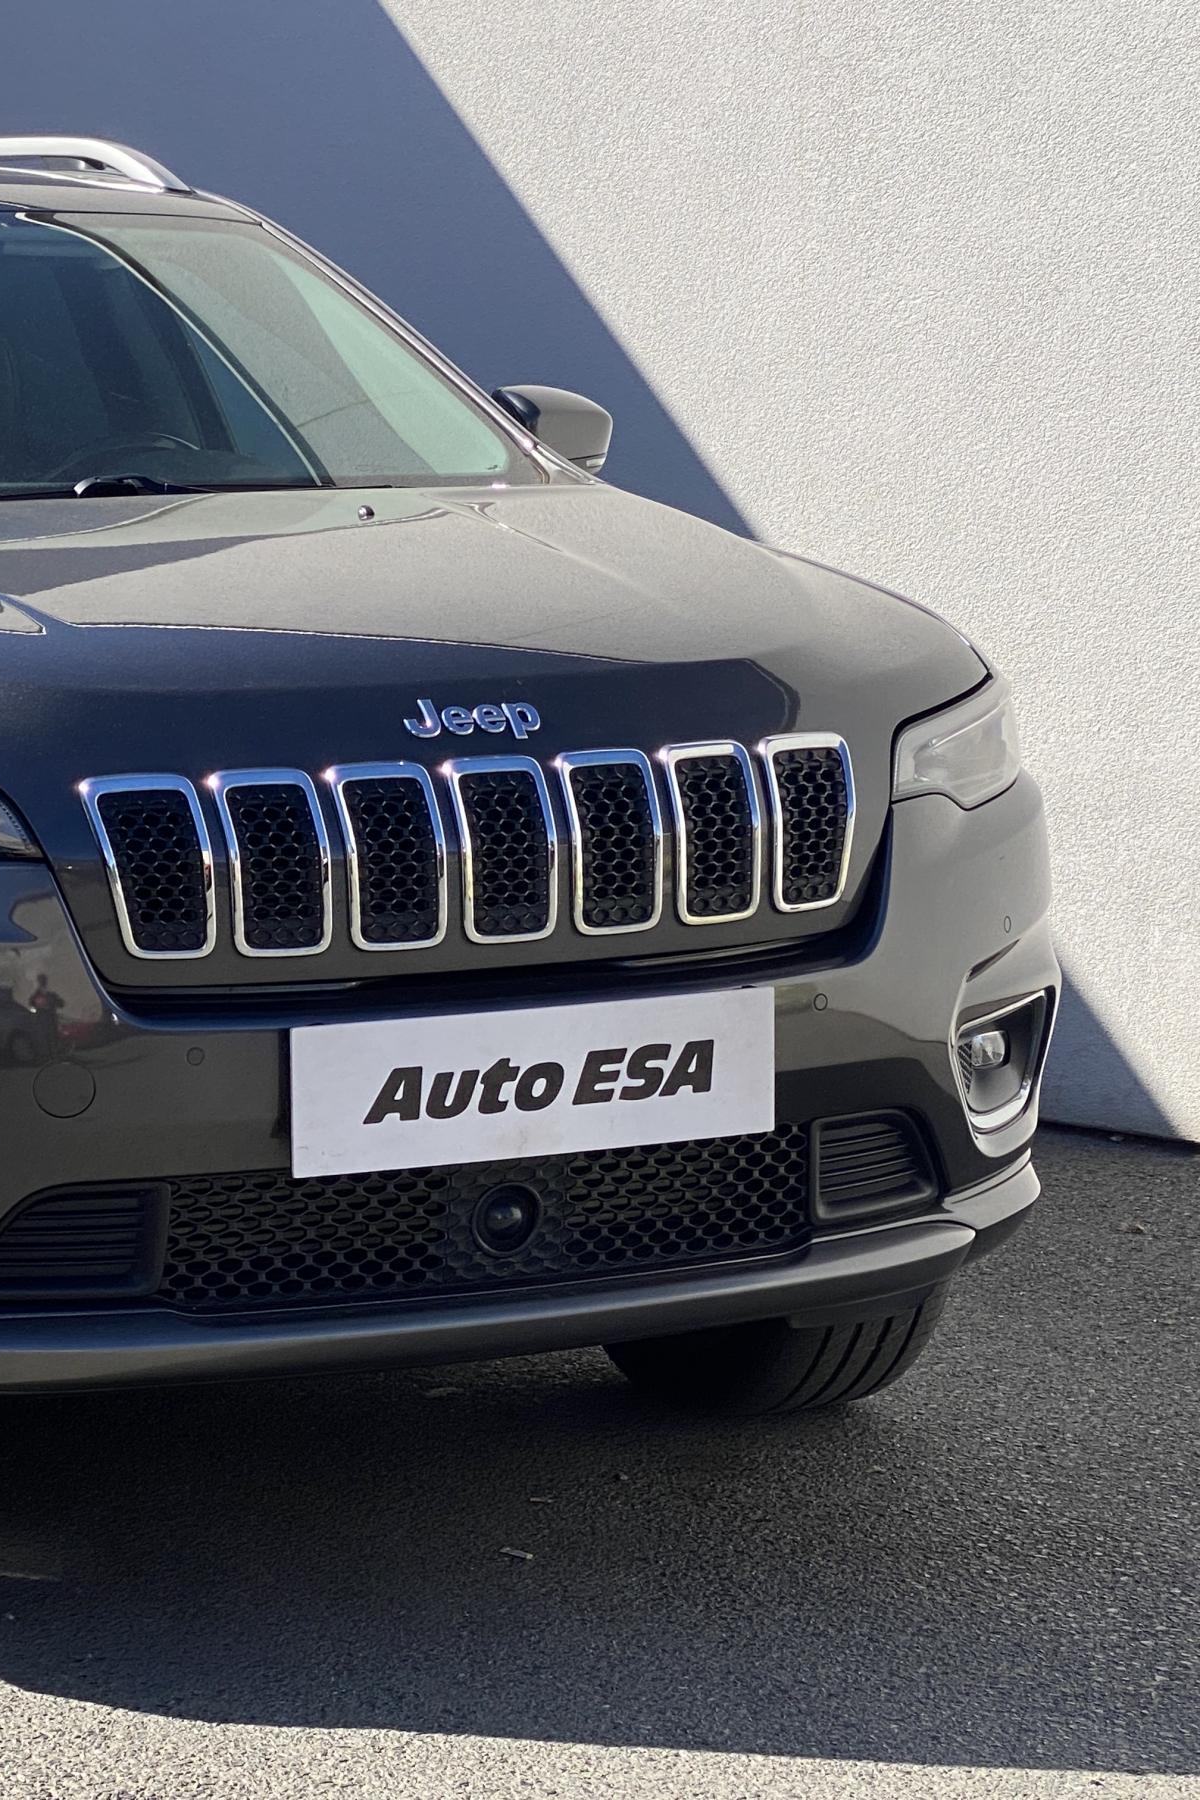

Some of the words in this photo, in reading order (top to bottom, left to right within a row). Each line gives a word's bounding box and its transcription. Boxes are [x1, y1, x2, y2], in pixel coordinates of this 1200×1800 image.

[403, 699, 541, 739] Jeep
[362, 1057, 564, 1125] Auto
[572, 1038, 715, 1106] ESA
